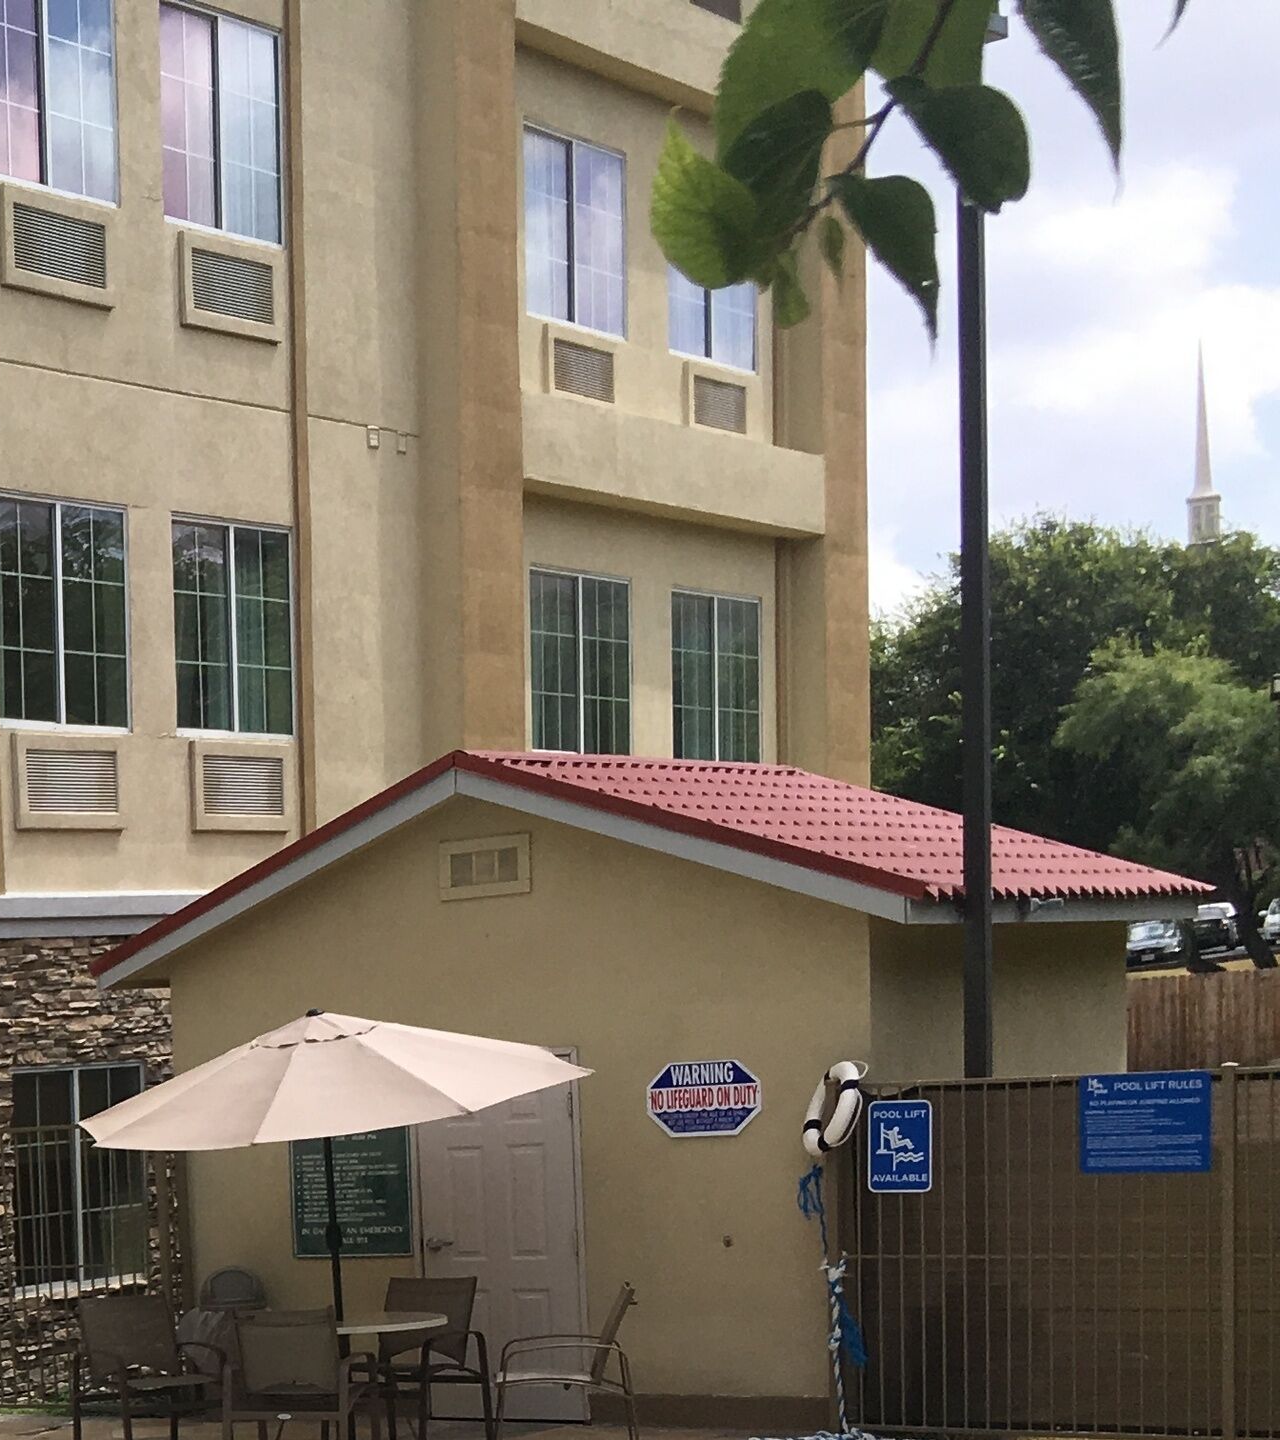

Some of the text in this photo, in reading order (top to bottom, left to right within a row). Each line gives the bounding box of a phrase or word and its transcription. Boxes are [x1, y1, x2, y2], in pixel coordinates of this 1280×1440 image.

[670, 1062, 734, 1085] WARNING
[1113, 1079, 1203, 1091] POOL LIFT RULES
[650, 1084, 758, 1110] NO LIFEGUARD ON DUTY
[873, 1109, 927, 1119] POOL LIFT
[872, 1173, 928, 1182] AVAILABLE
